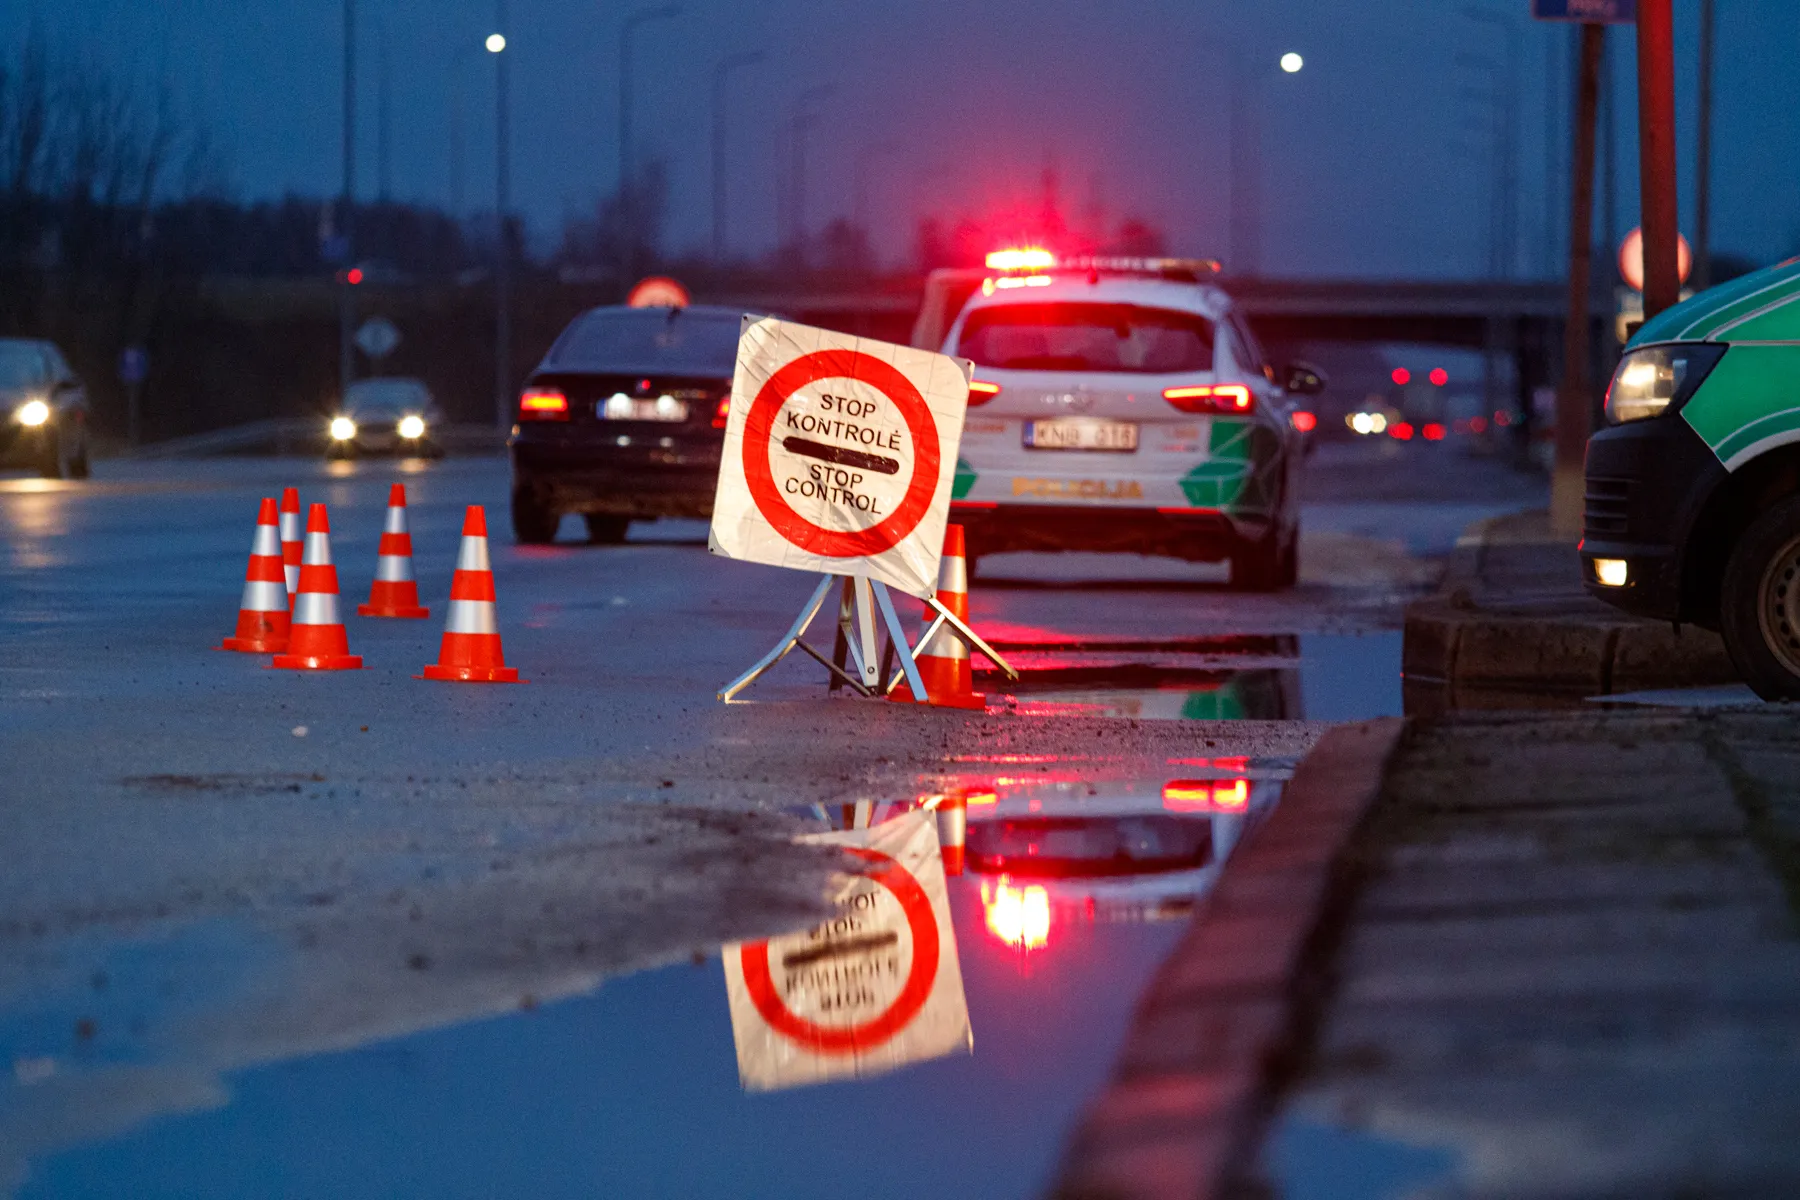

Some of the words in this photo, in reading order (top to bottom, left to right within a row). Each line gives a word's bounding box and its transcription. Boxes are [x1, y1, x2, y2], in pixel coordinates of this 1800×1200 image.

[820, 394, 876, 419] STOP
[787, 411, 902, 451] KONTROLĖ
[810, 464, 863, 489] STOP
[1012, 477, 1144, 499] POLICIJA
[785, 477, 882, 515] CONTROL
